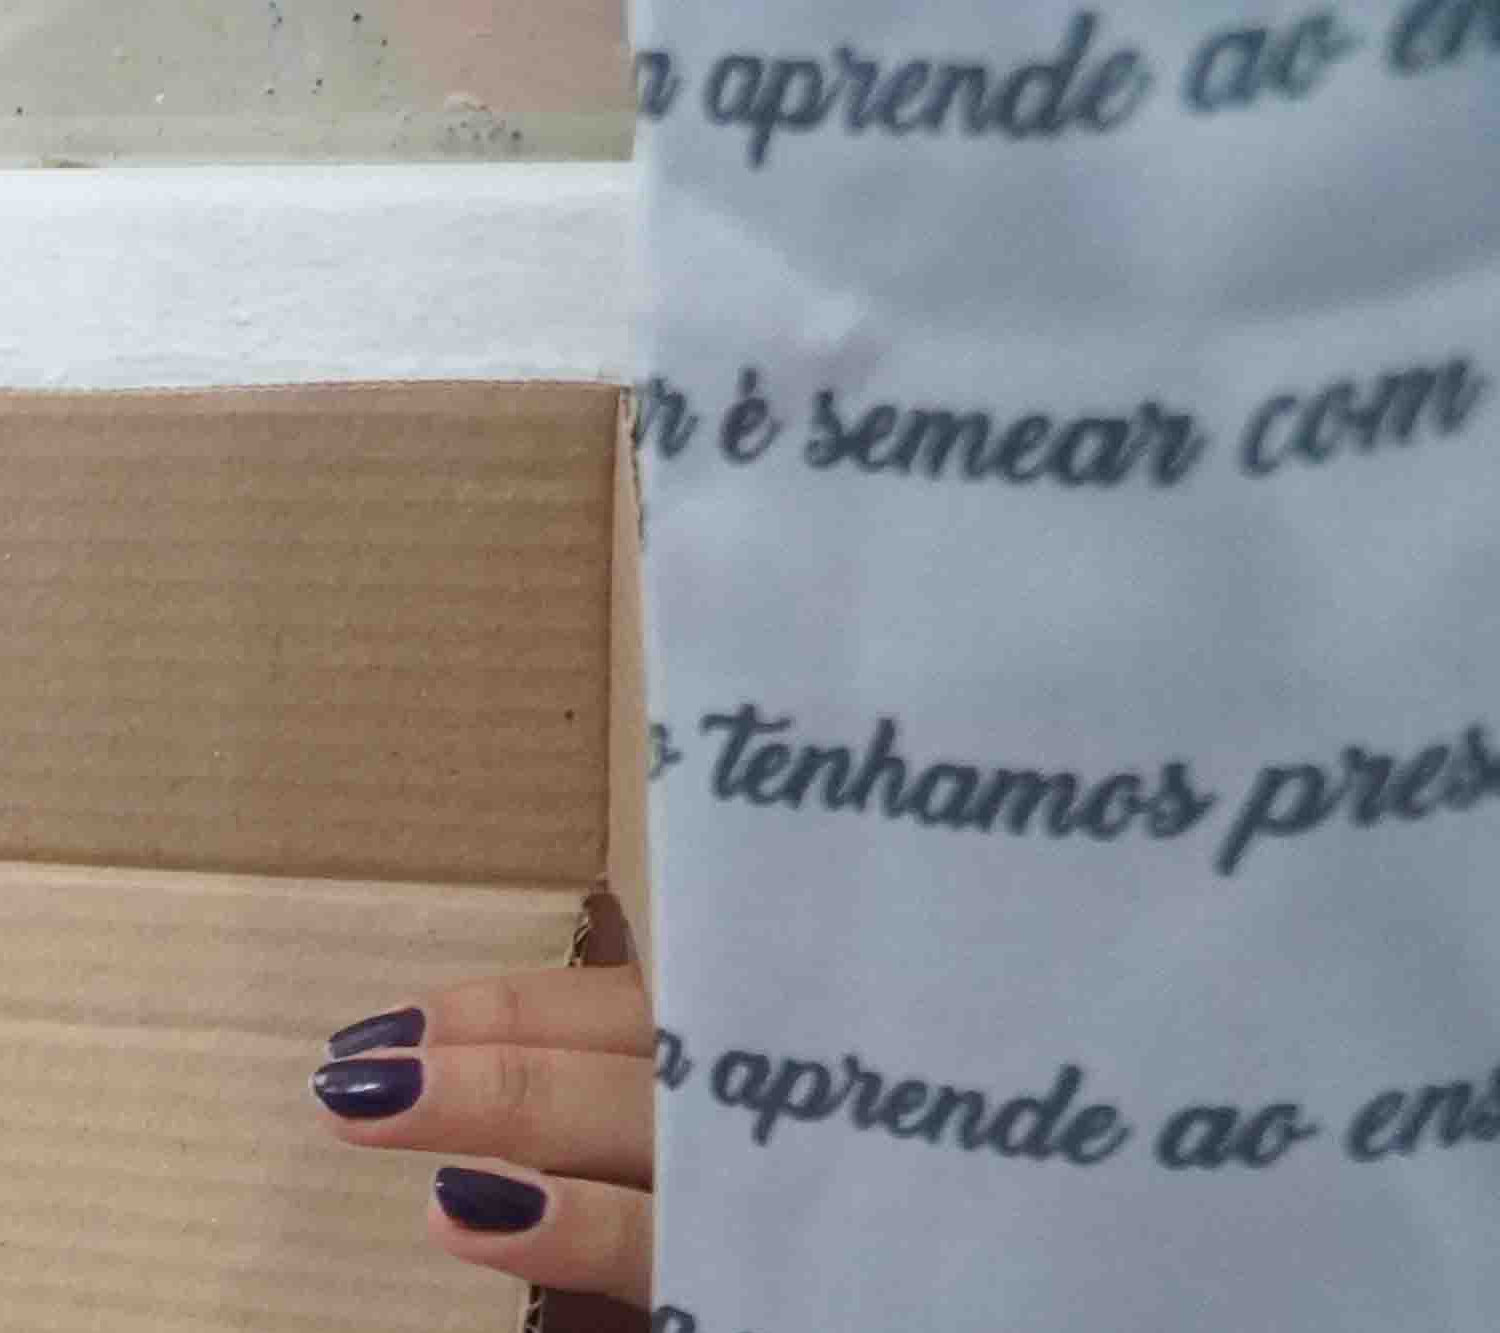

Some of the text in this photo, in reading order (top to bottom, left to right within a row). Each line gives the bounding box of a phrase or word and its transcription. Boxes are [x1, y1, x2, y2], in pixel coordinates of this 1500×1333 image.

[705, 12, 1156, 170] aprende
[1178, 18, 1363, 115] ao
[803, 387, 1208, 489] semear
[1236, 354, 1486, 479] com
[701, 702, 1214, 843] tenhamos
[710, 1047, 1130, 1168] aprende
[1155, 1101, 1316, 1171] ao
